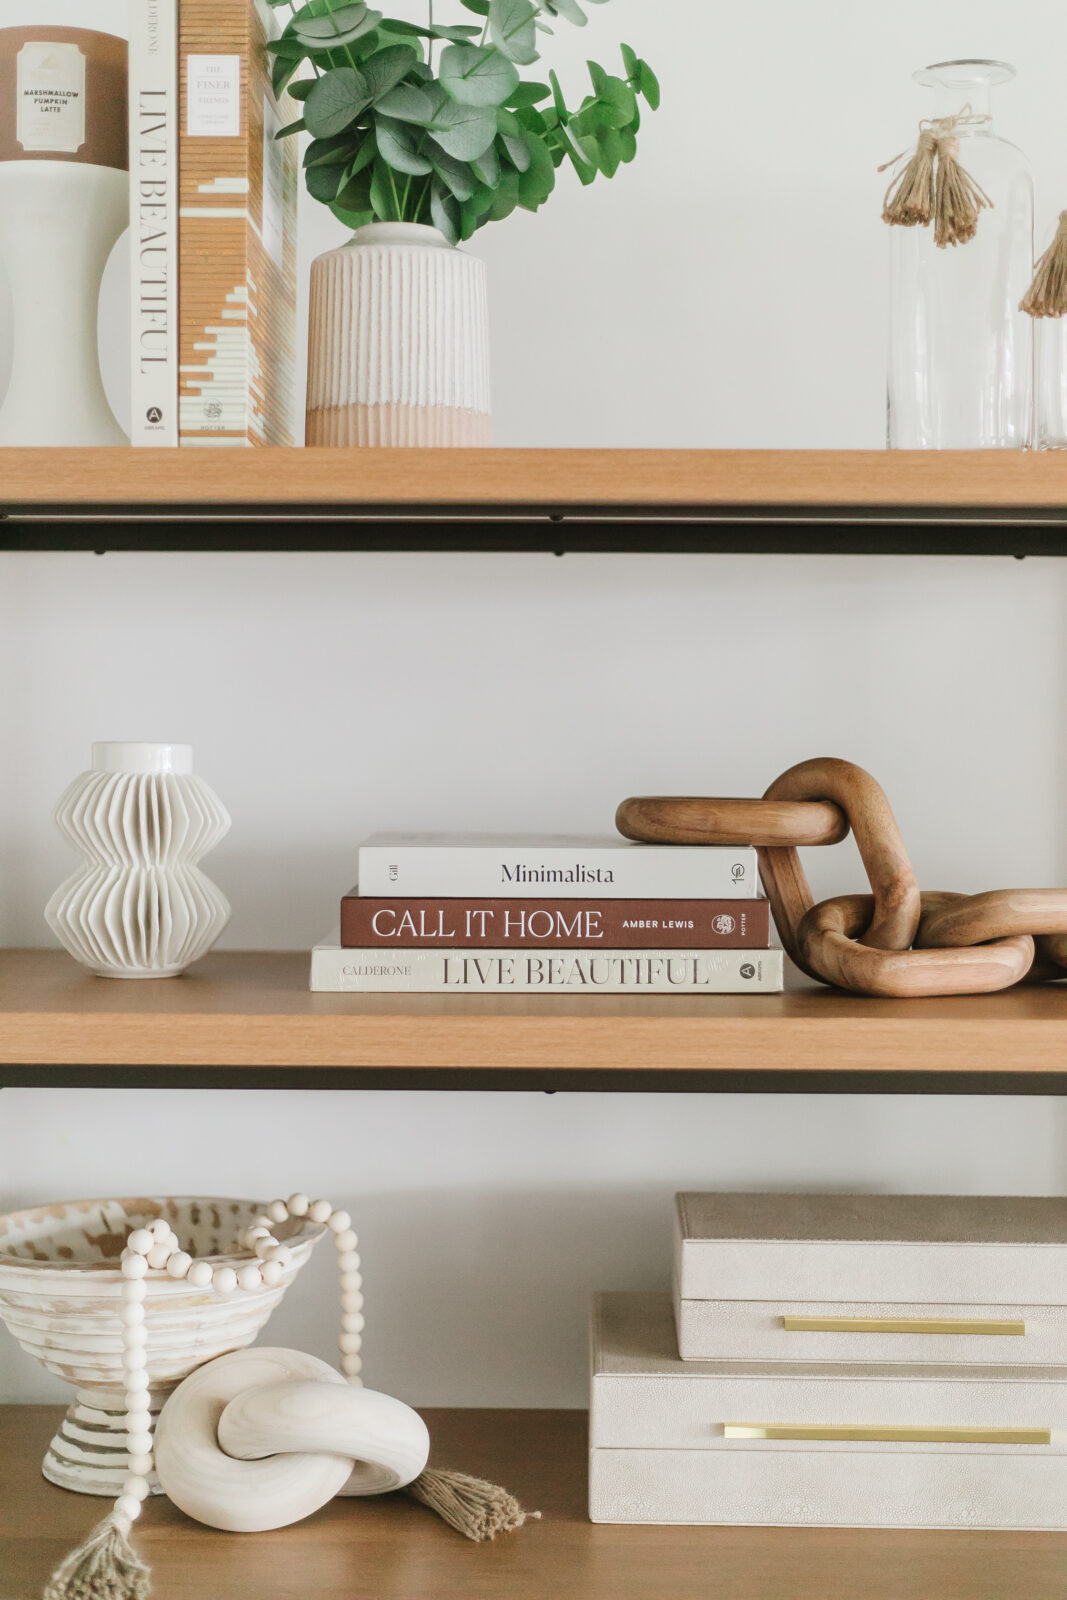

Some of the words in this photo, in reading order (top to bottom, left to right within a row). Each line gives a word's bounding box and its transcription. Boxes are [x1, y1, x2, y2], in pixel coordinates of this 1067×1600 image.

[23, 89, 79, 98] MARSHMALLOW
[197, 80, 230, 89] FINER
[140, 89, 167, 166] LIVE
[139, 180, 168, 374] BEAUTIFUL
[389, 864, 399, 881] Gill
[501, 863, 614, 883] Minimalista
[371, 909, 456, 938] CALL
[465, 910, 495, 938] IT
[504, 910, 604, 938] HOME
[622, 920, 659, 929] AMBER
[662, 920, 694, 929] LEWIS
[342, 966, 412, 976] CALDERONE
[442, 958, 515, 985] LIVE
[525, 958, 710, 985] BEAUTIFUL
